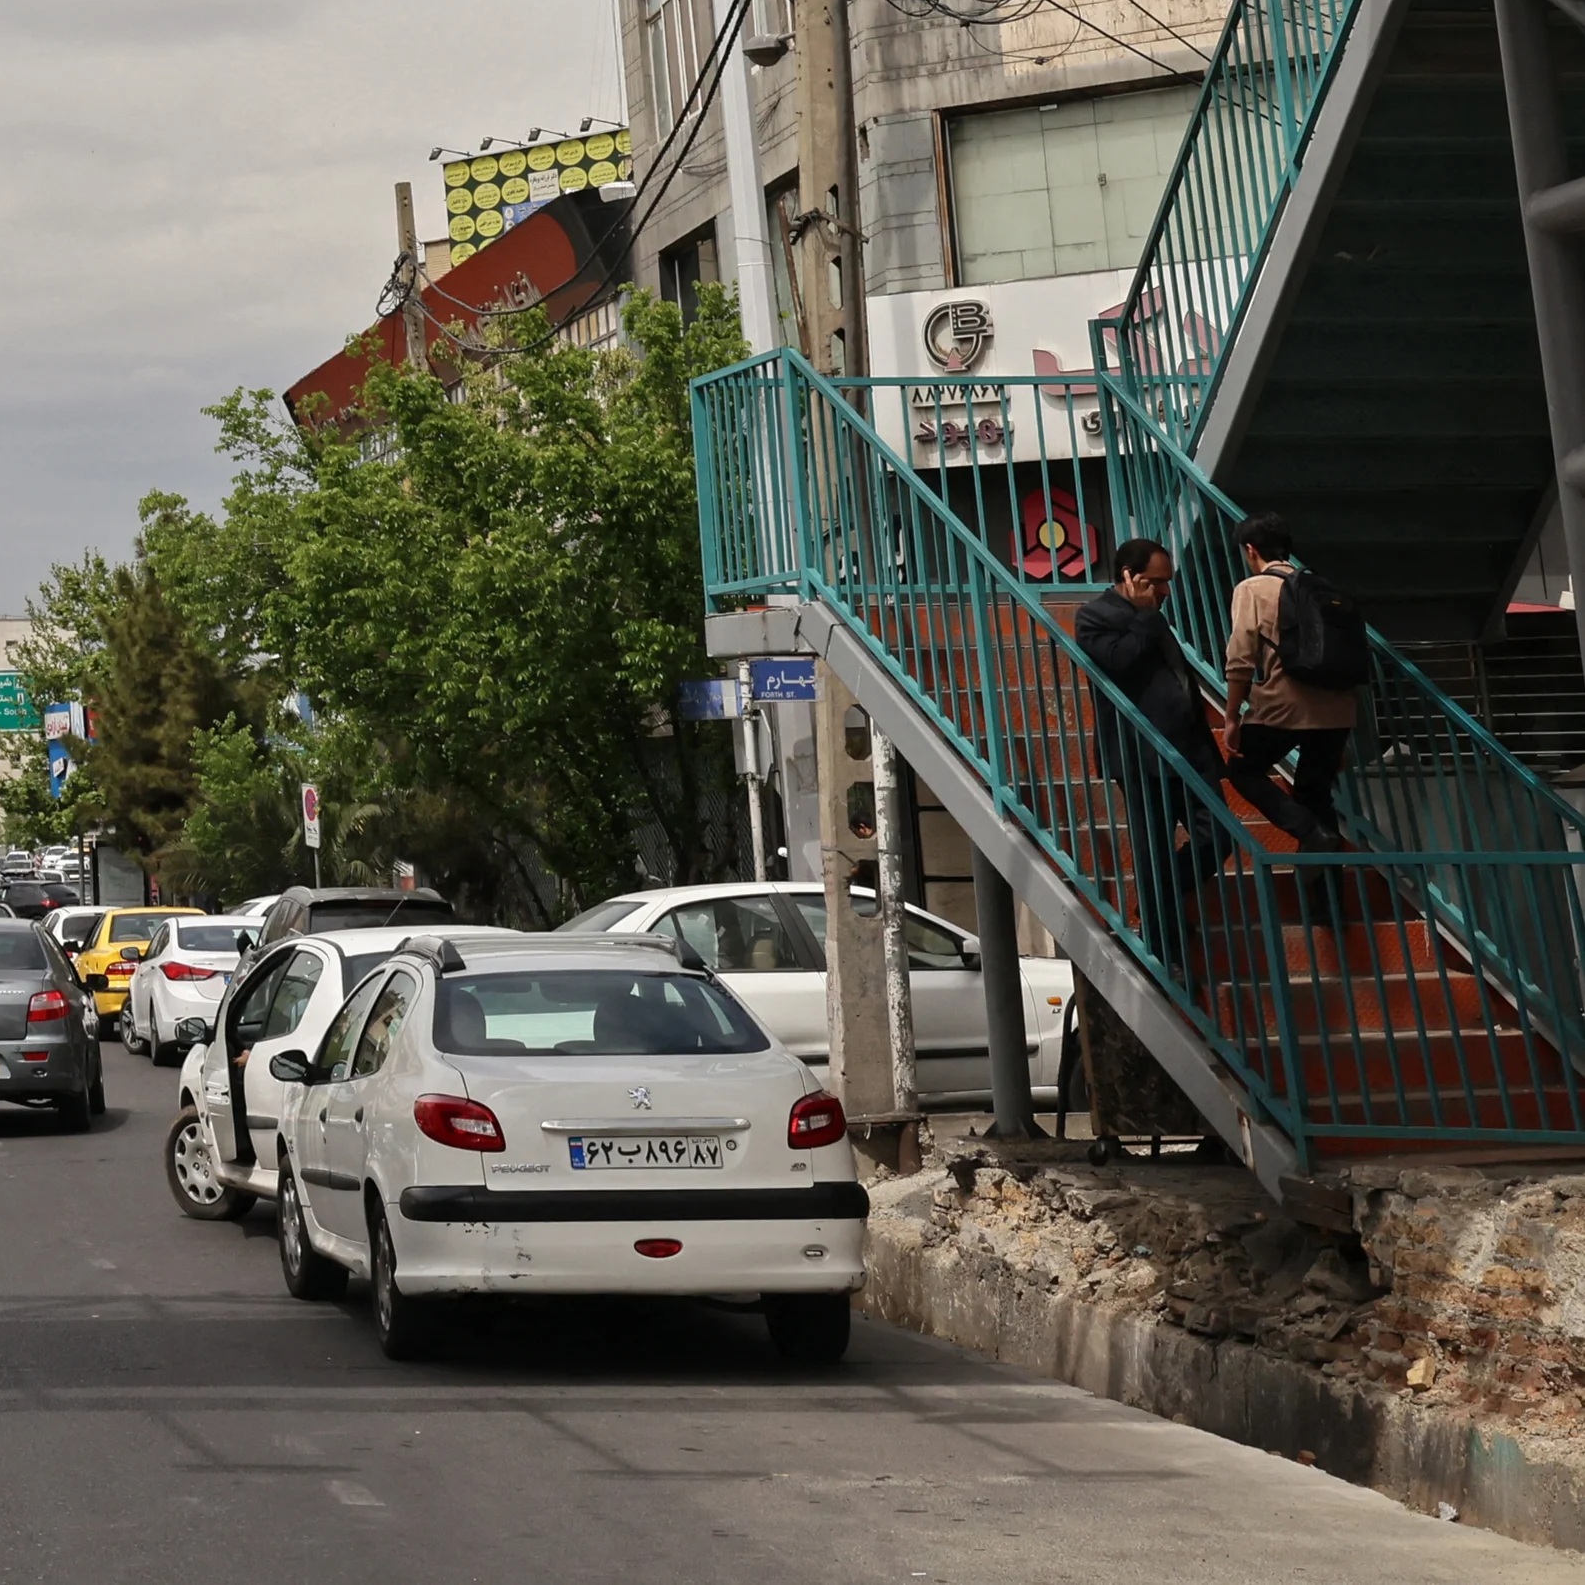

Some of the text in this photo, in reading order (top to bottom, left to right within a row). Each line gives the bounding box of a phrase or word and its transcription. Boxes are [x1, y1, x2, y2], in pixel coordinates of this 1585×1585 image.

[761, 691, 797, 699] FORTH ST.
[587, 1140, 718, 1165] ۶۲ ب ۸۹۶ ۸۷
[491, 1164, 552, 1174] PEUGEOT
